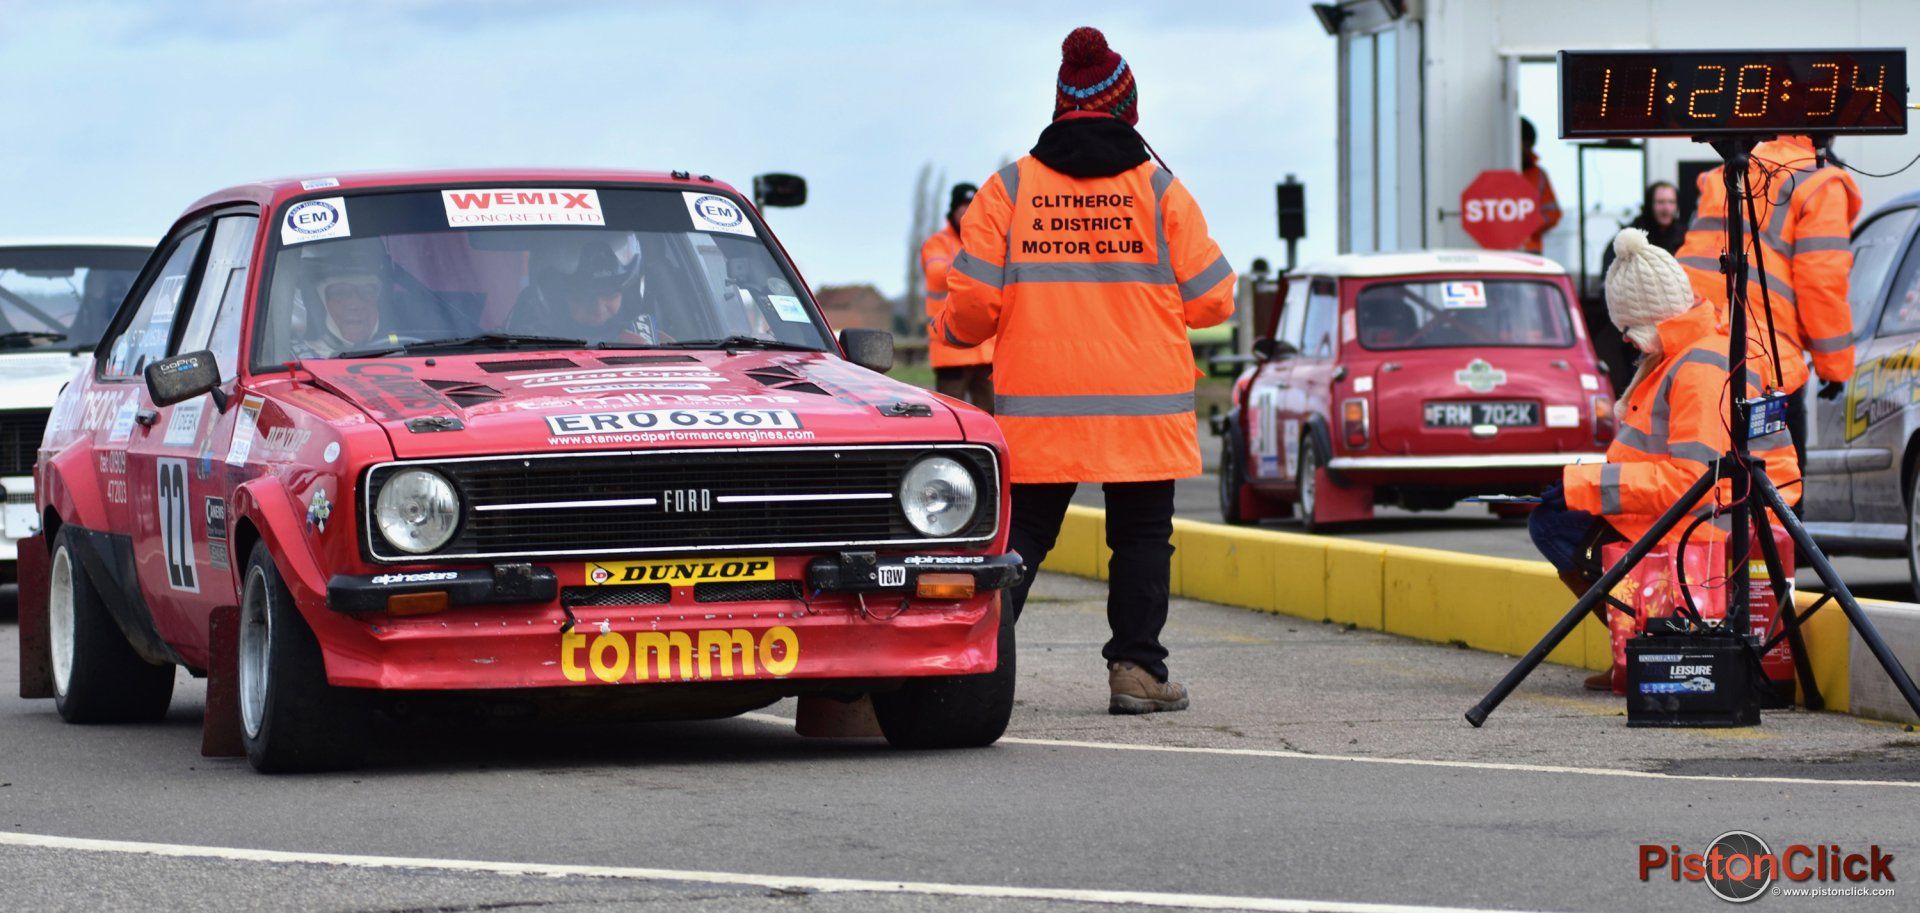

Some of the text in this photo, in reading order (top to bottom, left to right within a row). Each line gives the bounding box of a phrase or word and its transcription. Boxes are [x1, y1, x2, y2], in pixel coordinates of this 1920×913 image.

[1600, 64, 1885, 118] 11:28:34
[449, 192, 594, 210] WEMIX
[1031, 194, 1134, 208] CLITHEROE
[299, 211, 328, 224] EM
[450, 212, 601, 224] CONCRETE LTD
[705, 205, 732, 218] EM
[1466, 198, 1535, 222] STOP
[1032, 217, 1134, 231] & DISTRICT
[1022, 240, 1144, 254] MOTOR CLUB
[160, 357, 198, 371] GoPro
[555, 410, 785, 431] ERO 636T
[1431, 402, 1532, 425] FRM 702K
[547, 429, 815, 446] www.stanwoodperformanceengines.com
[664, 488, 710, 513] FORD
[159, 463, 196, 588] 22
[904, 556, 984, 566] alpinestars
[372, 571, 458, 585] alpinestars
[620, 560, 769, 582] DUNLOP
[880, 568, 904, 585] TOW
[560, 621, 800, 683] tommo
[1669, 665, 1714, 676] LEISURE
